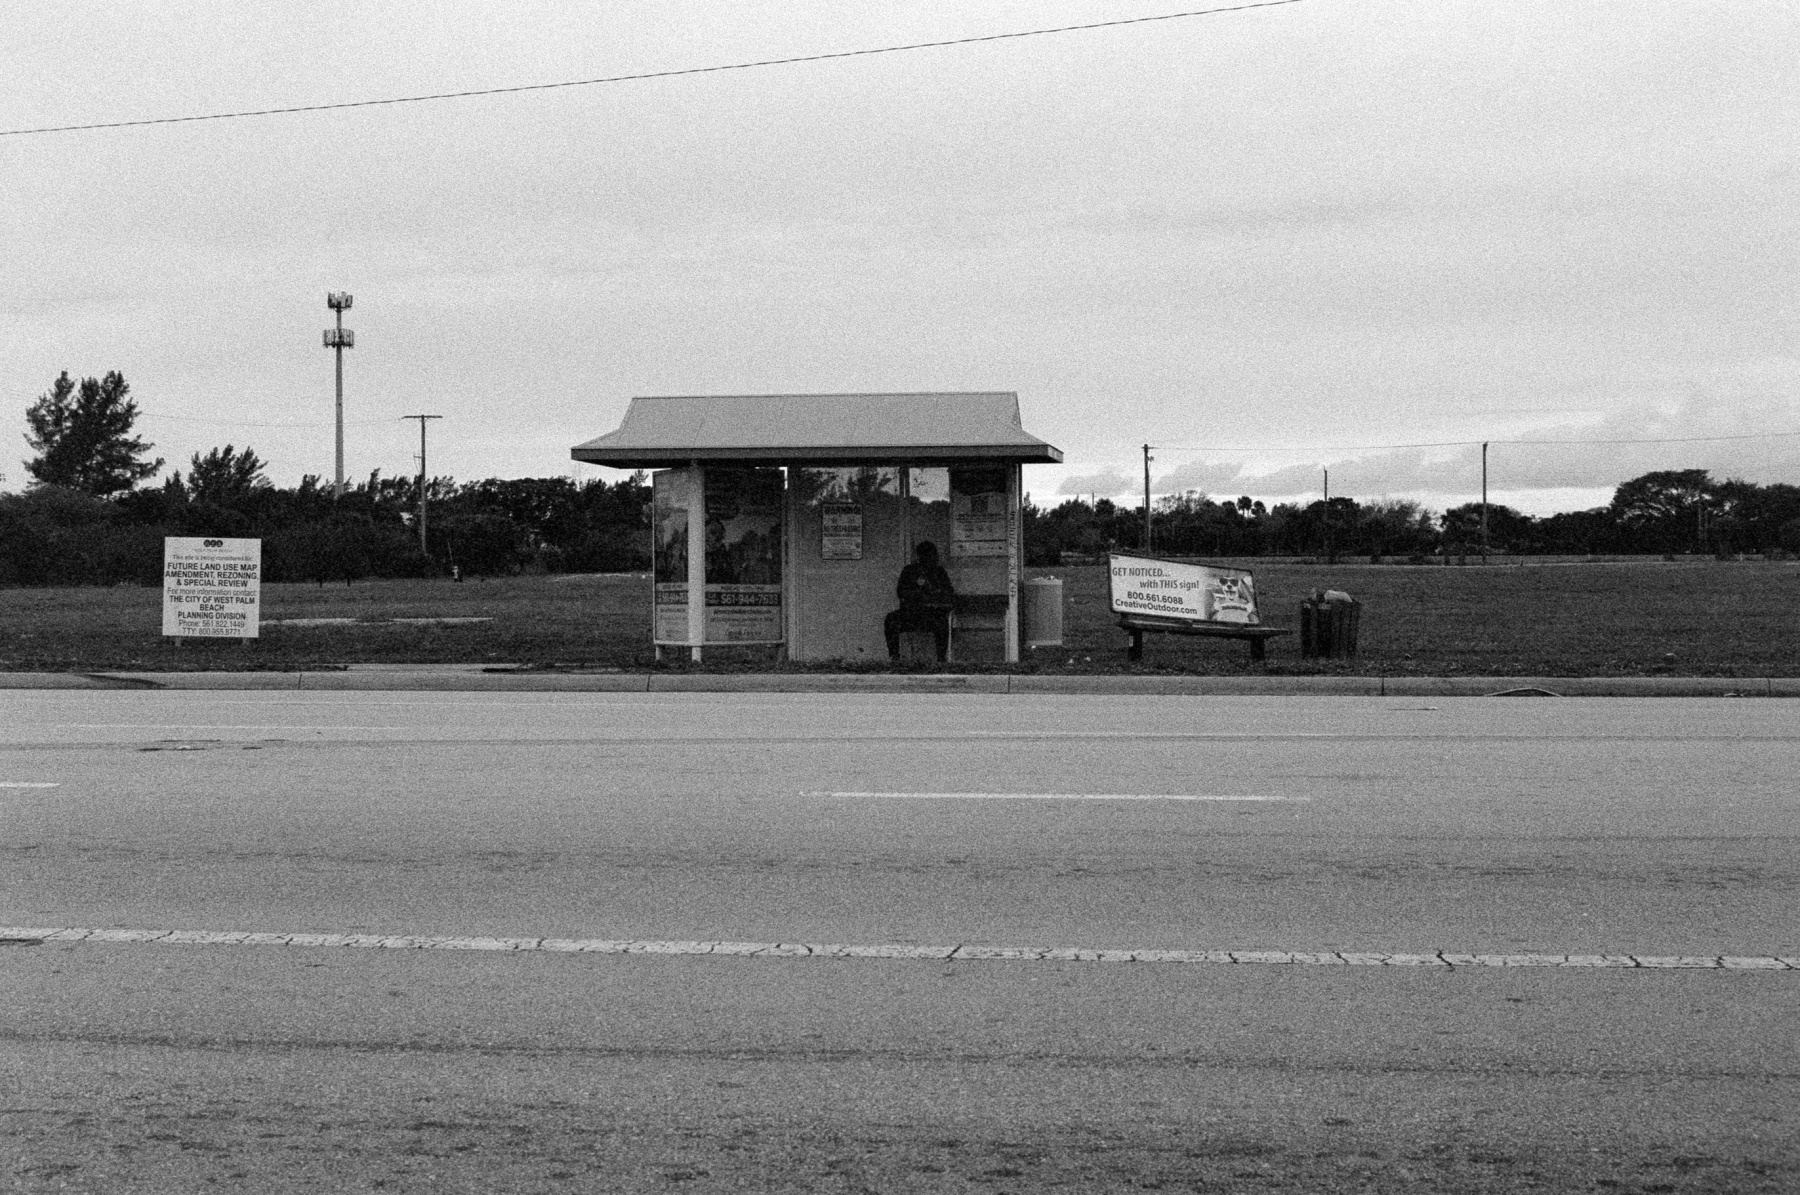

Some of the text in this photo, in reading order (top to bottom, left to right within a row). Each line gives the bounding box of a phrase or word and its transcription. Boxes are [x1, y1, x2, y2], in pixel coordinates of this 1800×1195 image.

[165, 570, 215, 579] AMENDMENT,
[1113, 568, 1171, 577] GET NOTICED...
[1140, 580, 1199, 591] with THIS sign!
[1128, 591, 1183, 605] 800.661.6088
[1115, 598, 1198, 614] CreativeOutdoor.com
